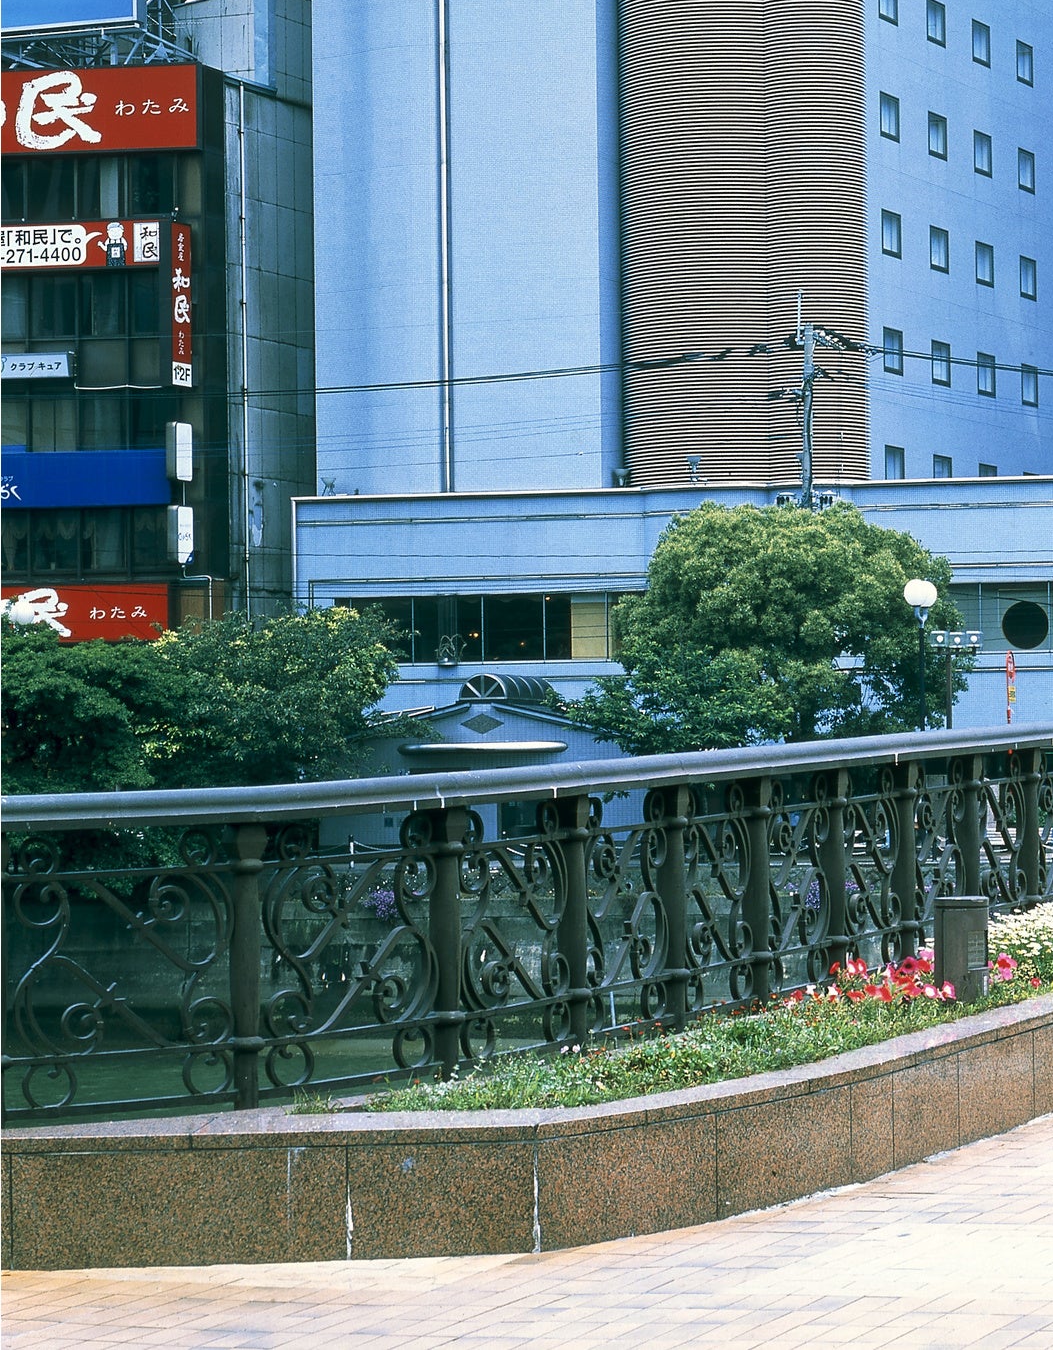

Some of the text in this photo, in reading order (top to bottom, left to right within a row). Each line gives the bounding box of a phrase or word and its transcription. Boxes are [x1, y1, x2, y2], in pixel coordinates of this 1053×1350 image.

[1, 70, 190, 150] 民 わたみ
[139, 226, 159, 259] 和民
[172, 267, 191, 324] 和民
[89, 605, 148, 620] わたみ
